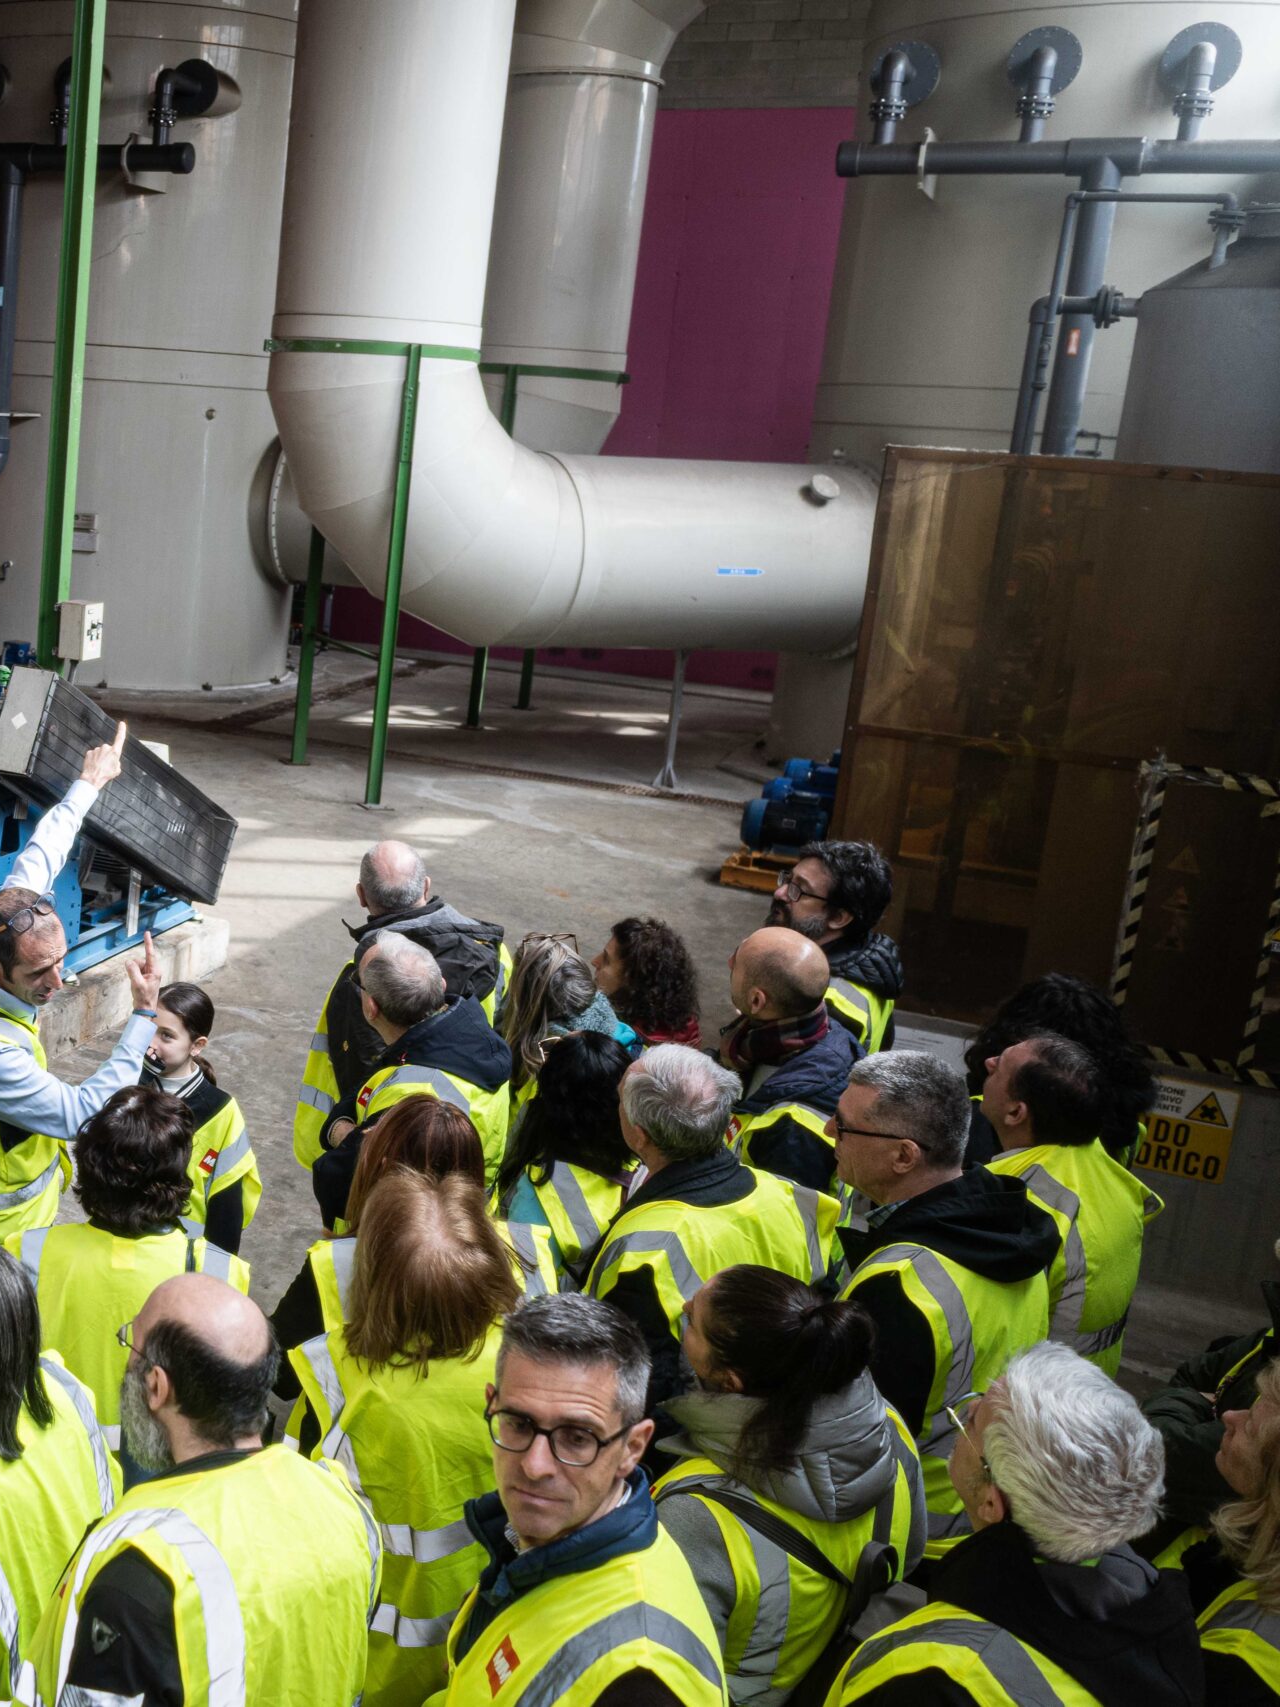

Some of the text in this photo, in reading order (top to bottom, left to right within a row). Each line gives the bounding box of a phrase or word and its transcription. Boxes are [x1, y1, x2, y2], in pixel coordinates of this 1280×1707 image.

[1159, 1085, 1186, 1096] ZIONE
[1160, 1095, 1182, 1104] SIVO
[1157, 1103, 1181, 1113] ANTE
[1135, 1141, 1220, 1180] DRICO
